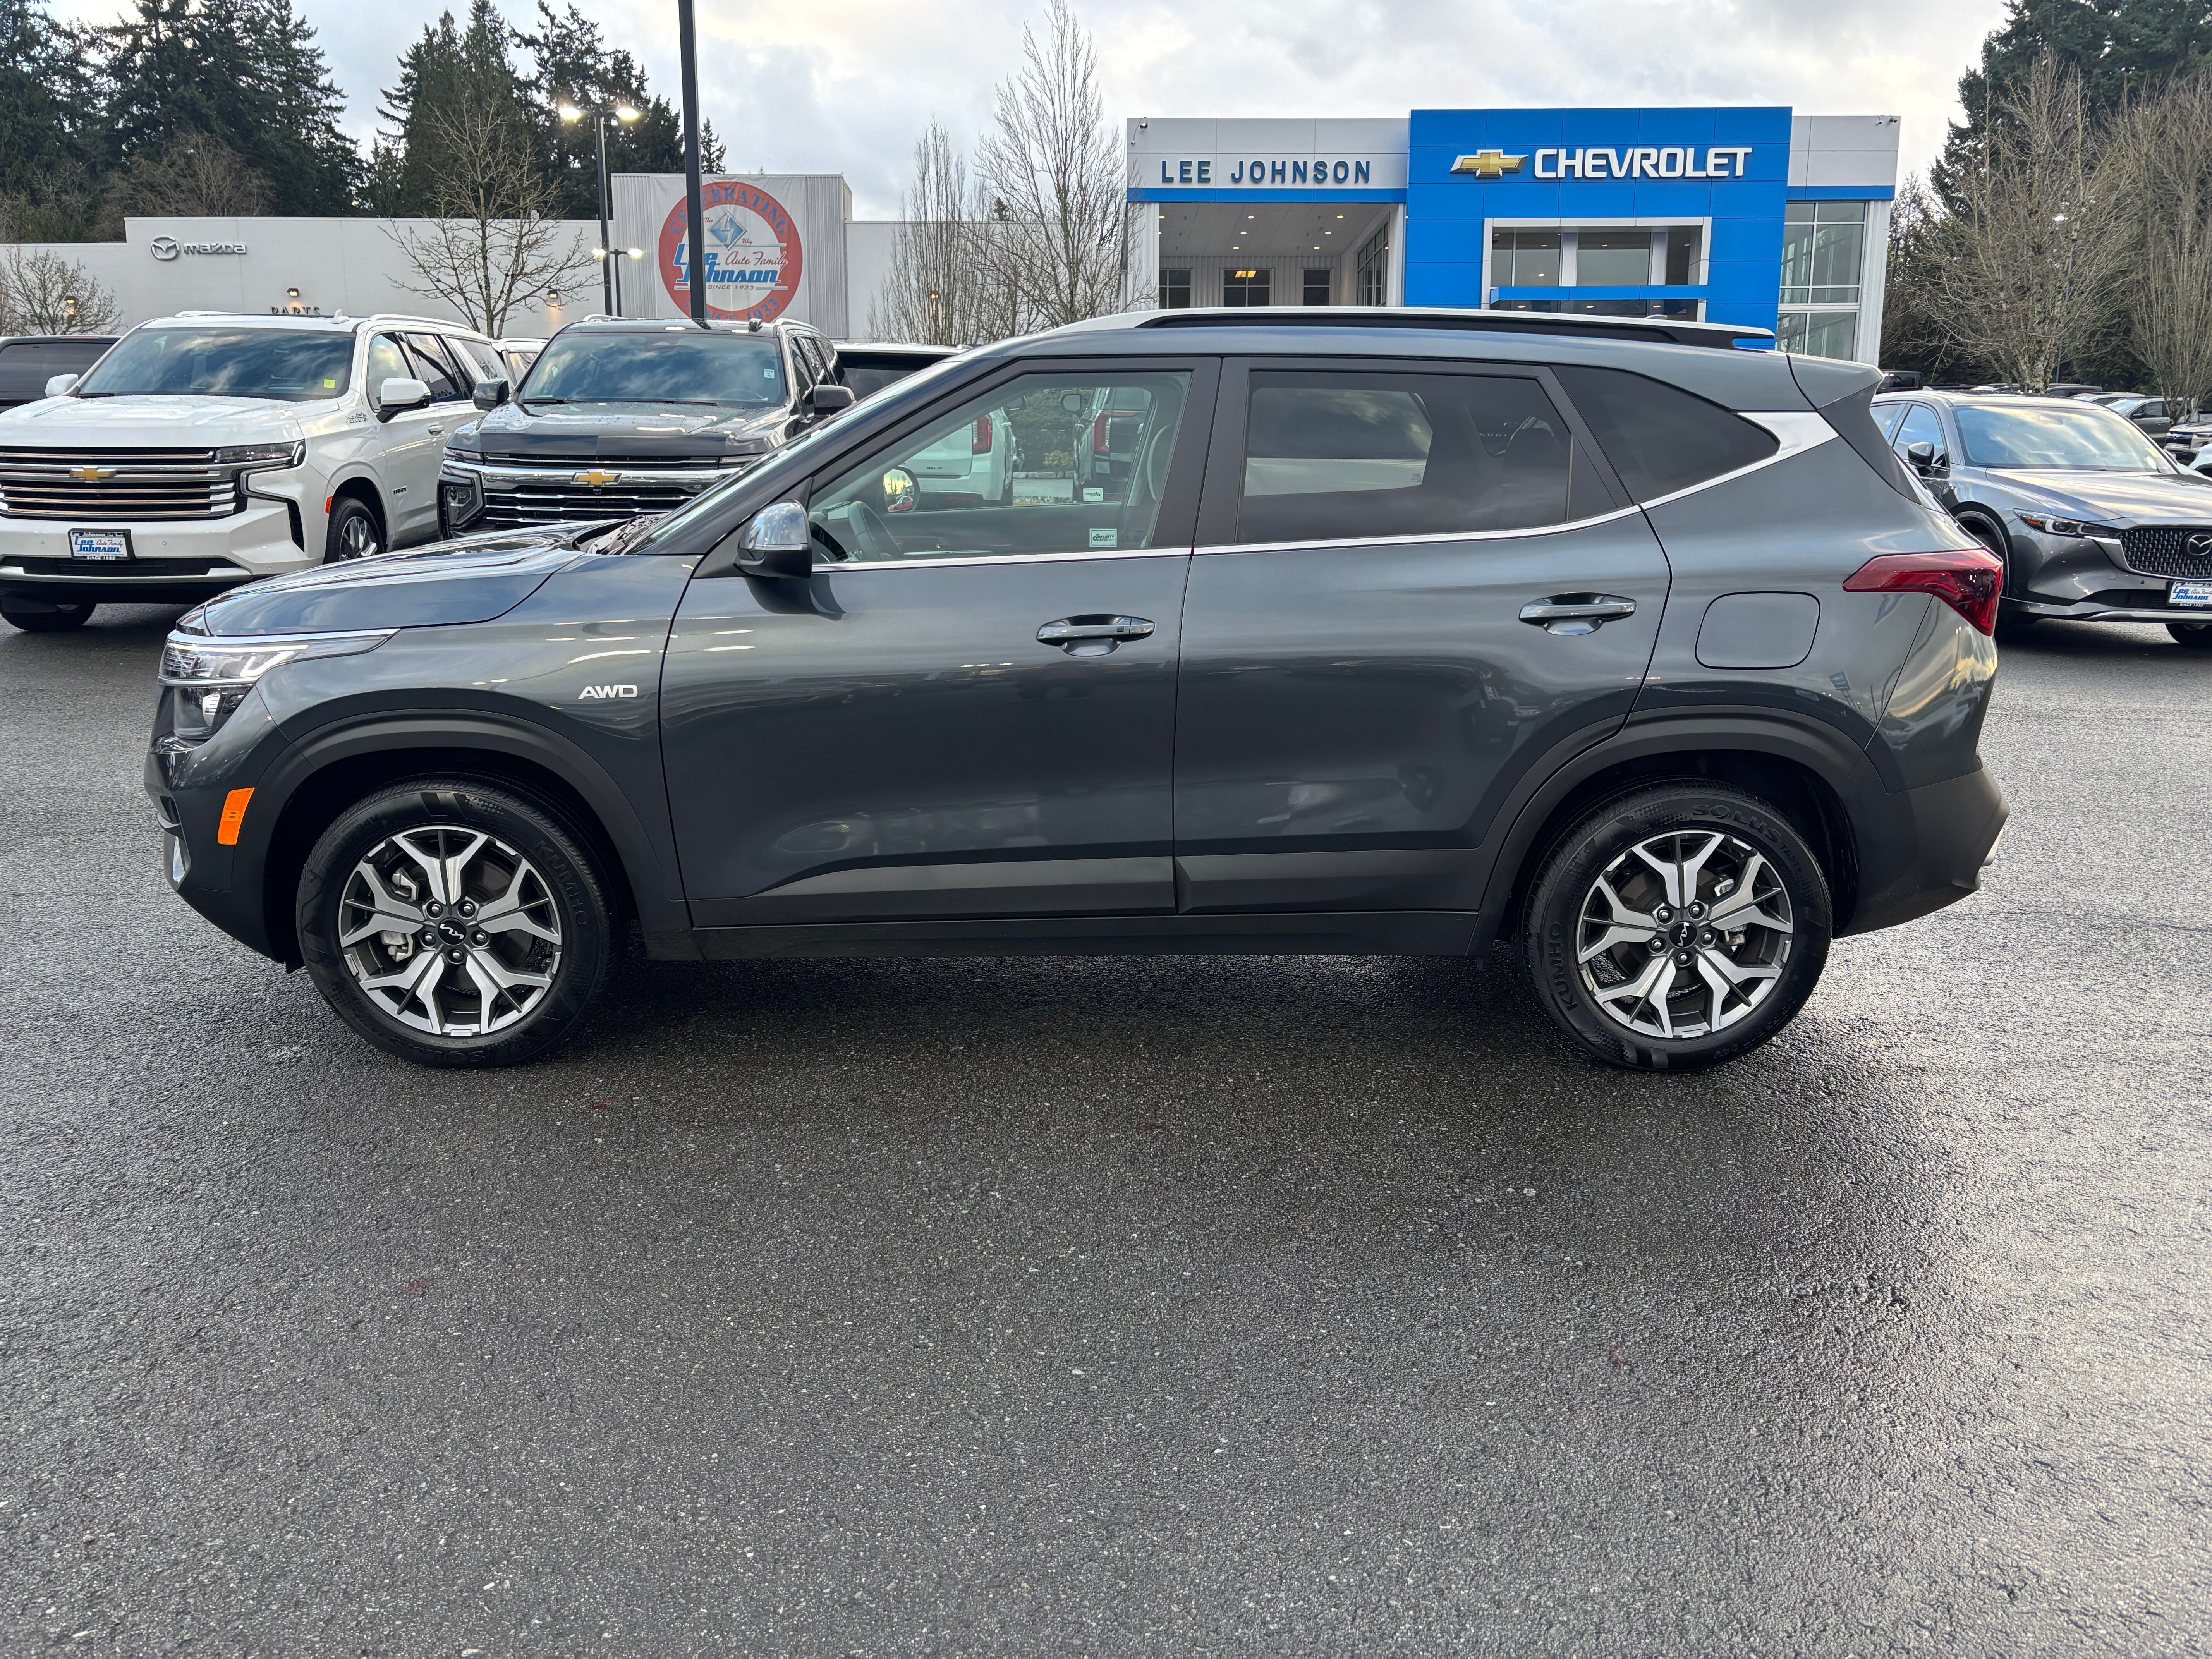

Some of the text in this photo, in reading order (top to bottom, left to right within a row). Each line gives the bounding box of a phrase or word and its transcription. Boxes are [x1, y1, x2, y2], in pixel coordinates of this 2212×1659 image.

[1161, 160, 1370, 184] LEE JOHNSON
[1535, 147, 1752, 178] CHEVROLET
[670, 187, 790, 233] CEEBRATING
[183, 242, 247, 254] mazda
[674, 243, 788, 270] Le Auto Family
[677, 262, 781, 282] Jhnson
[74, 536, 94, 545] Lee
[77, 543, 121, 553] Johnson
[578, 684, 638, 700] AWD
[1692, 804, 1782, 843] SOLUS
[534, 839, 589, 925] KUMHO
[1548, 922, 1579, 1012] KUMHO
